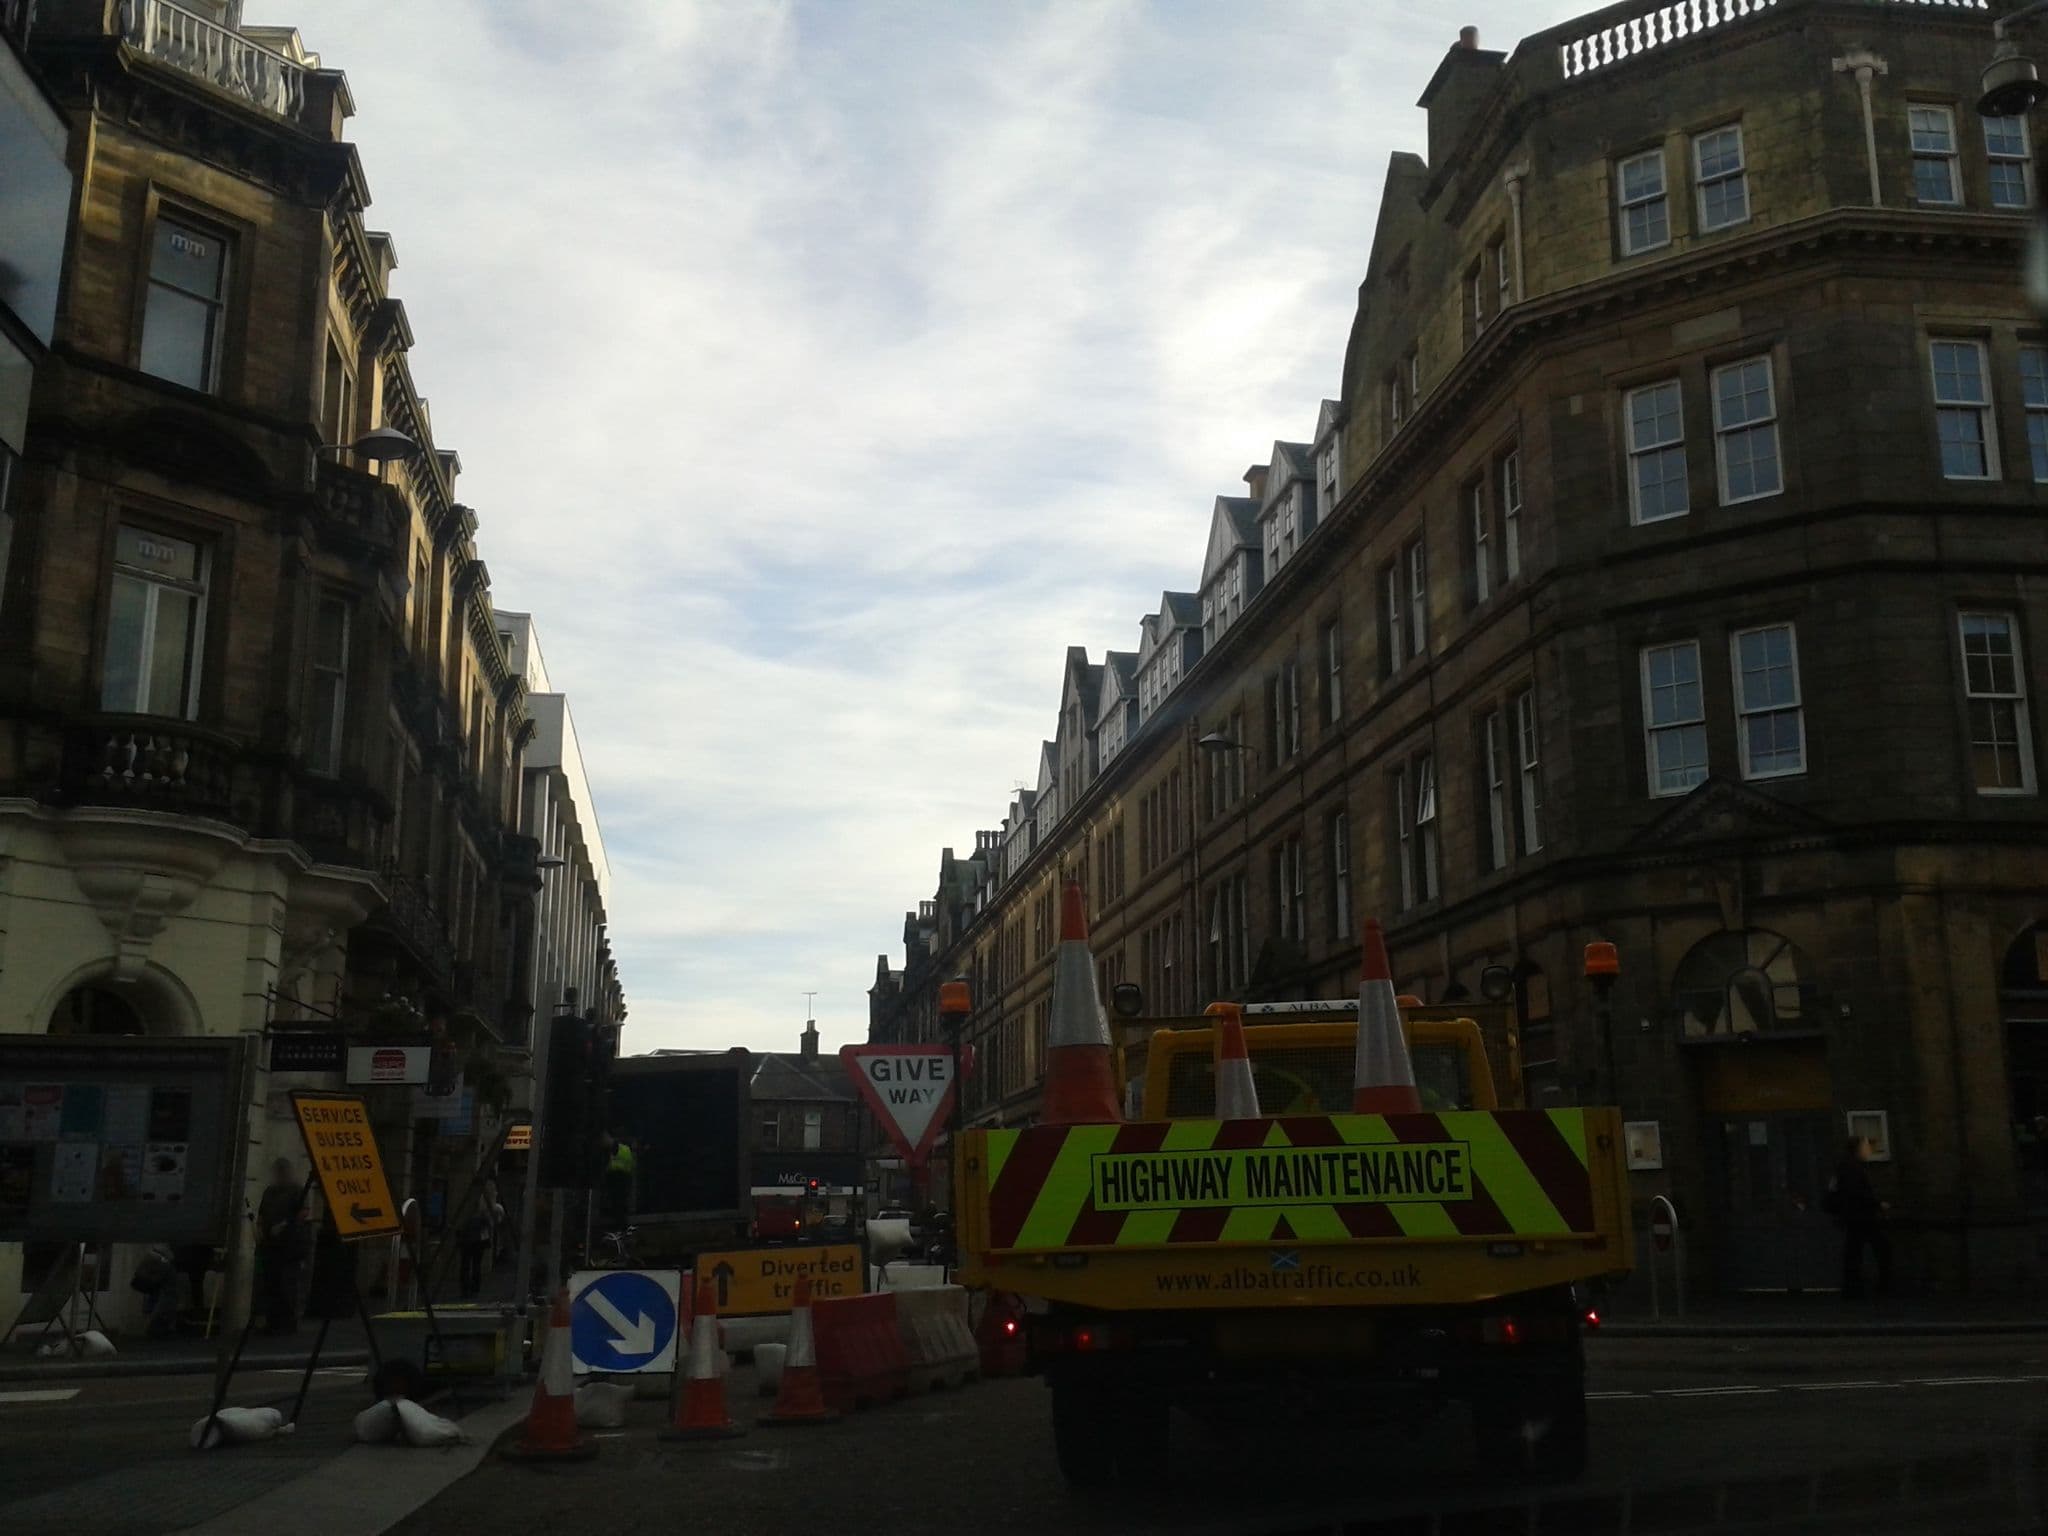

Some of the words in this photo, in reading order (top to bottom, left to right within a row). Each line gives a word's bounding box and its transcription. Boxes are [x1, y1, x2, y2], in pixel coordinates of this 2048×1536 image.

[1288, 1002, 1330, 1011] ALBA
[870, 1059, 945, 1082] GIVE
[889, 1088, 936, 1104] WAY
[303, 1107, 362, 1123] SERVICE
[316, 1132, 363, 1146] BUSES
[322, 1157, 331, 1170] &
[333, 1155, 373, 1170] TAXIS
[1101, 1157, 1232, 1203] HIGHWAY
[1246, 1149, 1464, 1198] MAINTENANCE
[336, 1179, 371, 1195] ONLY
[762, 1256, 854, 1276] Diverted
[1156, 1264, 1422, 1292] www.albatraffic.co.uk
[773, 1280, 843, 1298] trffic
